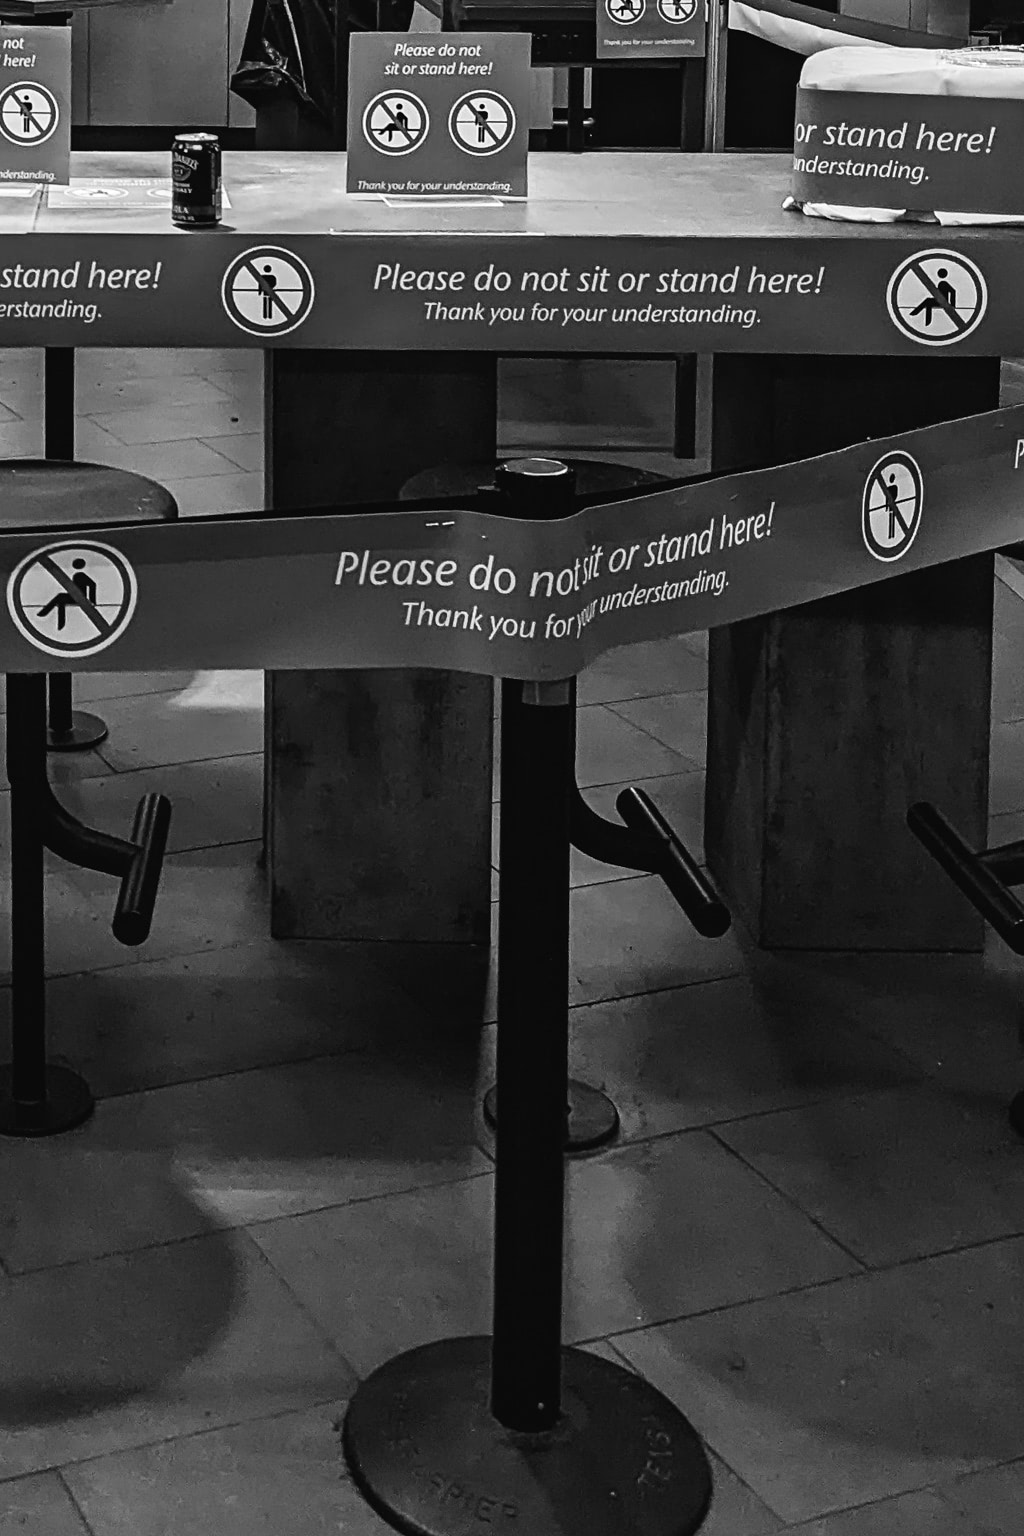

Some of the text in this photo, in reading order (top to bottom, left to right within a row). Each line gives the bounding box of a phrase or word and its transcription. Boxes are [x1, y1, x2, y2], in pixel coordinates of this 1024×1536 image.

[3, 38, 24, 49] not
[394, 43, 481, 57] Please do not
[4, 55, 36, 67] here!
[384, 62, 492, 75] sit or stand here!
[795, 122, 996, 154] or stand here!
[358, 180, 513, 192] Thank you for your understanding.
[0, 261, 81, 289] stand
[87, 261, 162, 289] here!
[373, 263, 825, 294] Please do not sit or stand here!
[424, 301, 761, 329] Thank you for your understanding.
[335, 501, 776, 598] Please do not sit or stand here!
[402, 569, 729, 641] Thank you for your understanding.
